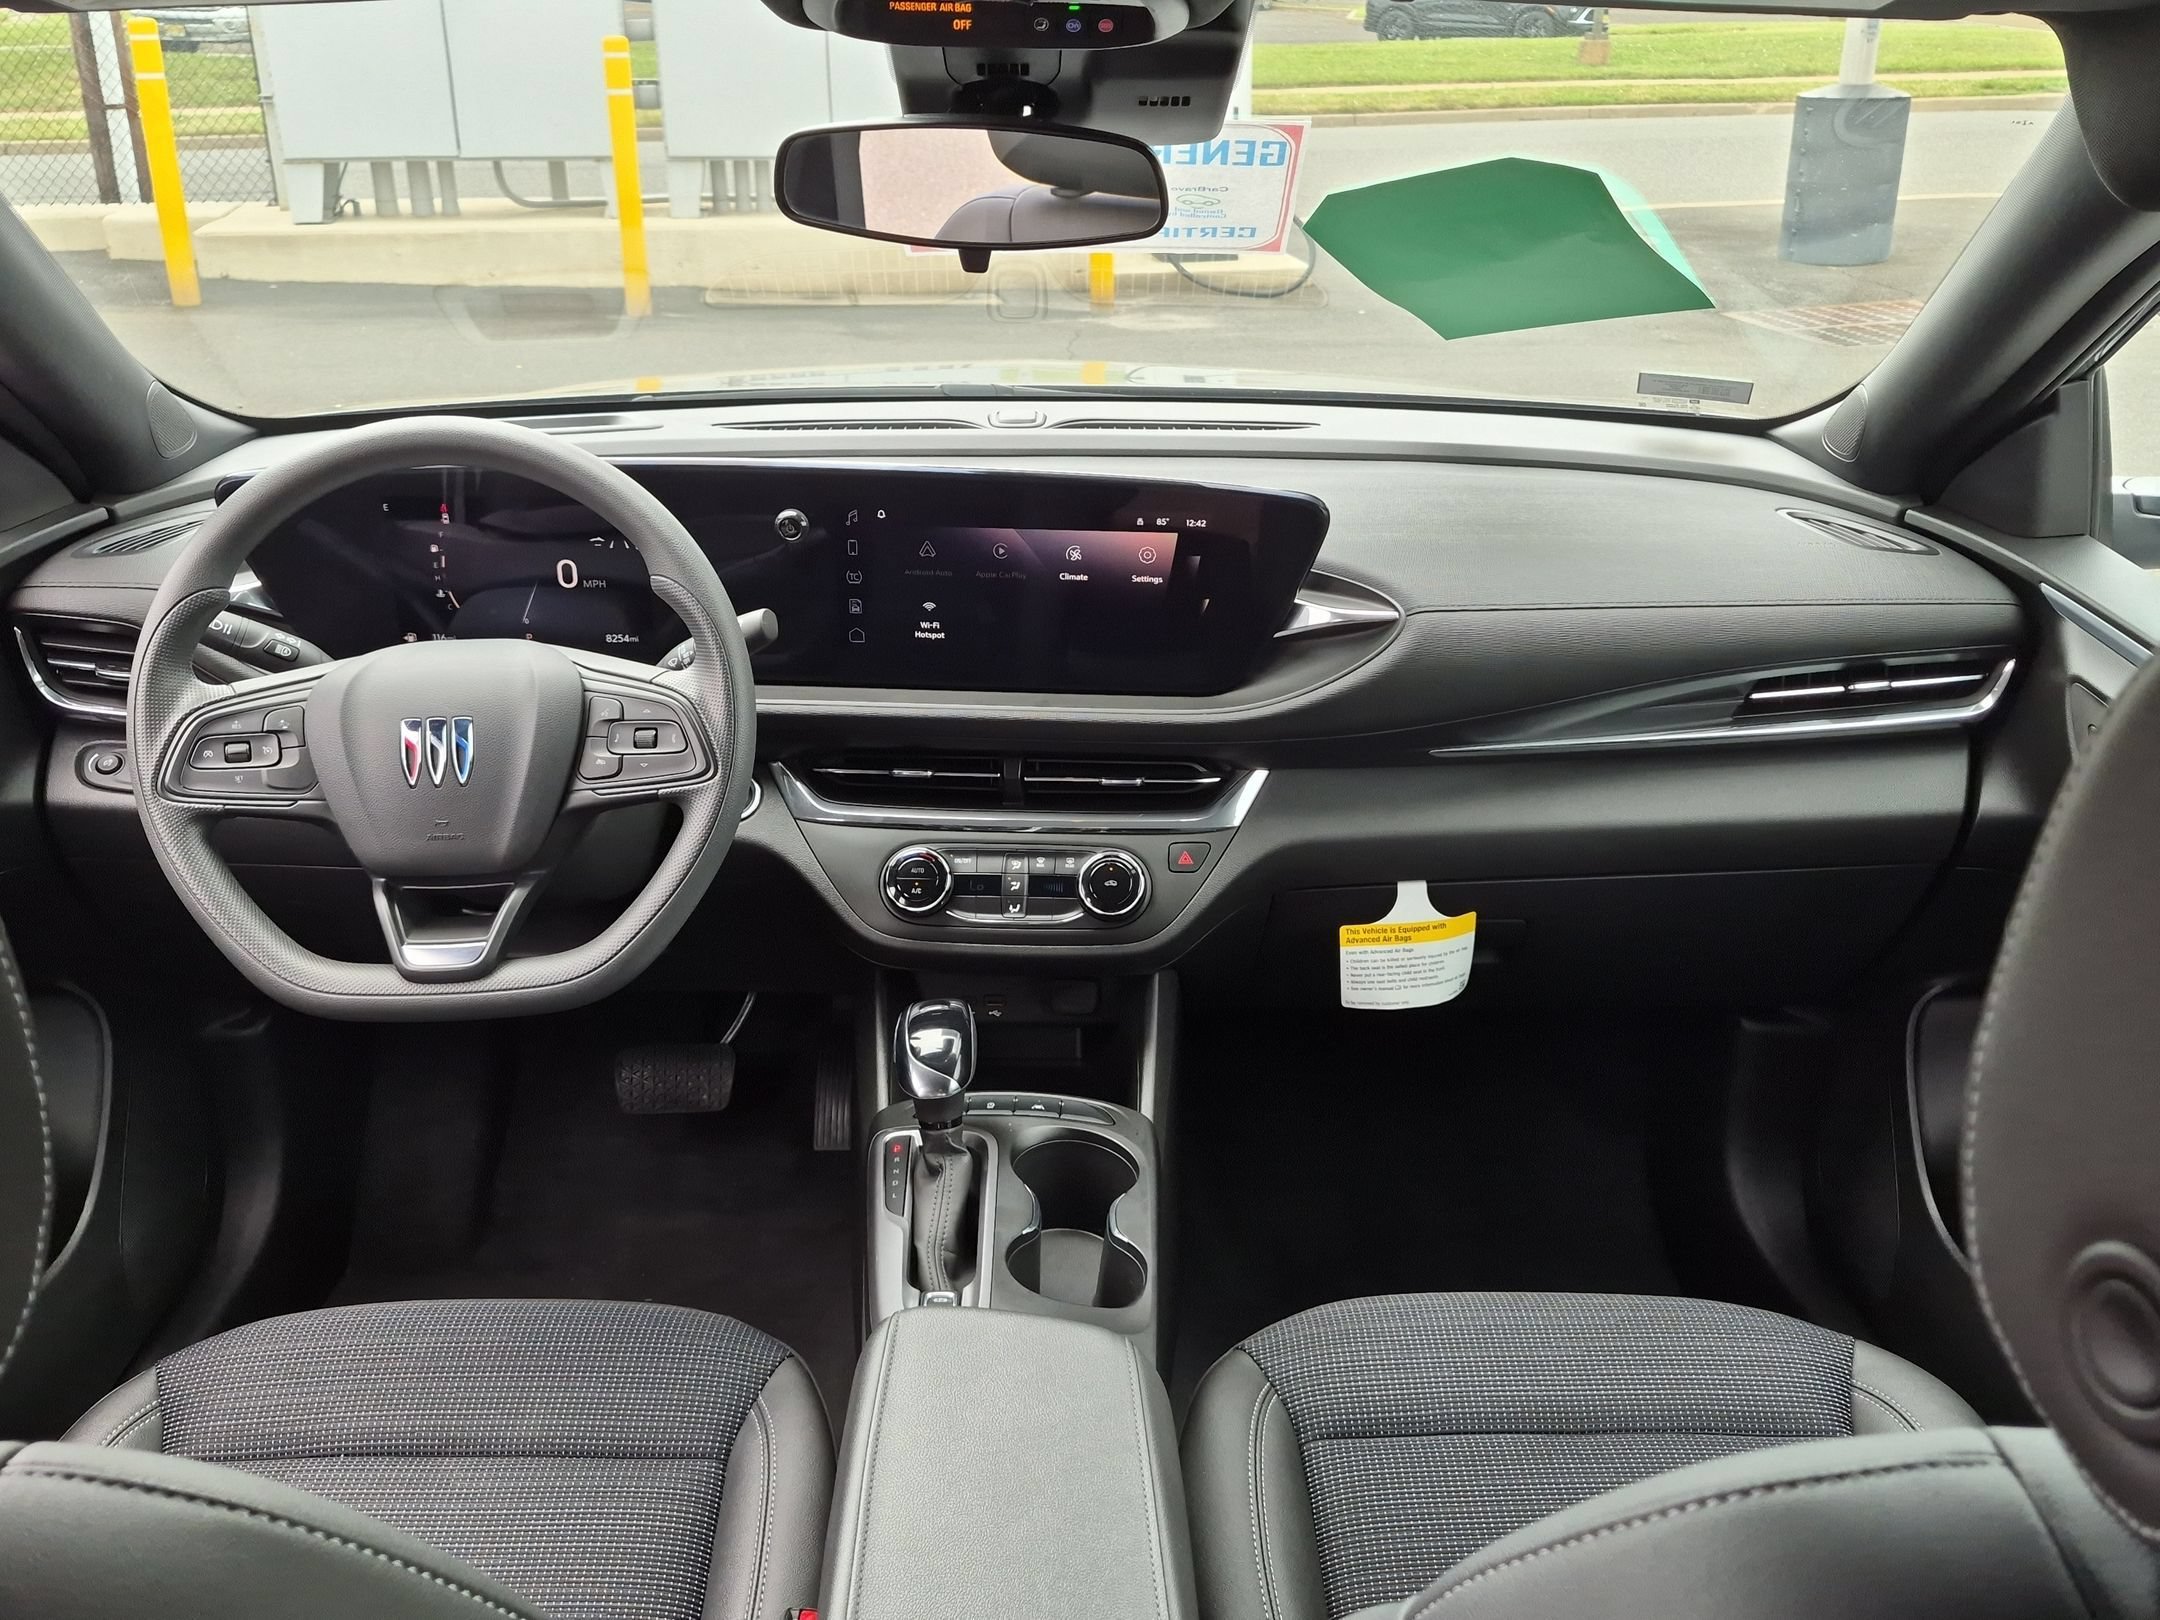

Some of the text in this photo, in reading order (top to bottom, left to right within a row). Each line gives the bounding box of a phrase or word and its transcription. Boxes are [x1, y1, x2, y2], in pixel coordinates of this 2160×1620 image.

[889, 1, 937, 12] PASSENGER
[953, 19, 972, 30] OFF
[382, 503, 389, 511] E
[1186, 519, 1207, 528] 12:42
[556, 559, 606, 589] 0 MPH
[1059, 572, 1089, 581] Climate
[1131, 574, 1163, 585] Settings
[920, 621, 940, 629] Wi-Fi
[914, 631, 945, 640] Hotspot
[1362, 927, 1388, 935] Vehicle
[1390, 926, 1396, 934] is
[1398, 923, 1431, 934] Equipped
[1432, 922, 1447, 930] with
[1346, 934, 1412, 944] Advanced Air Bags
[894, 1144, 901, 1153] P
